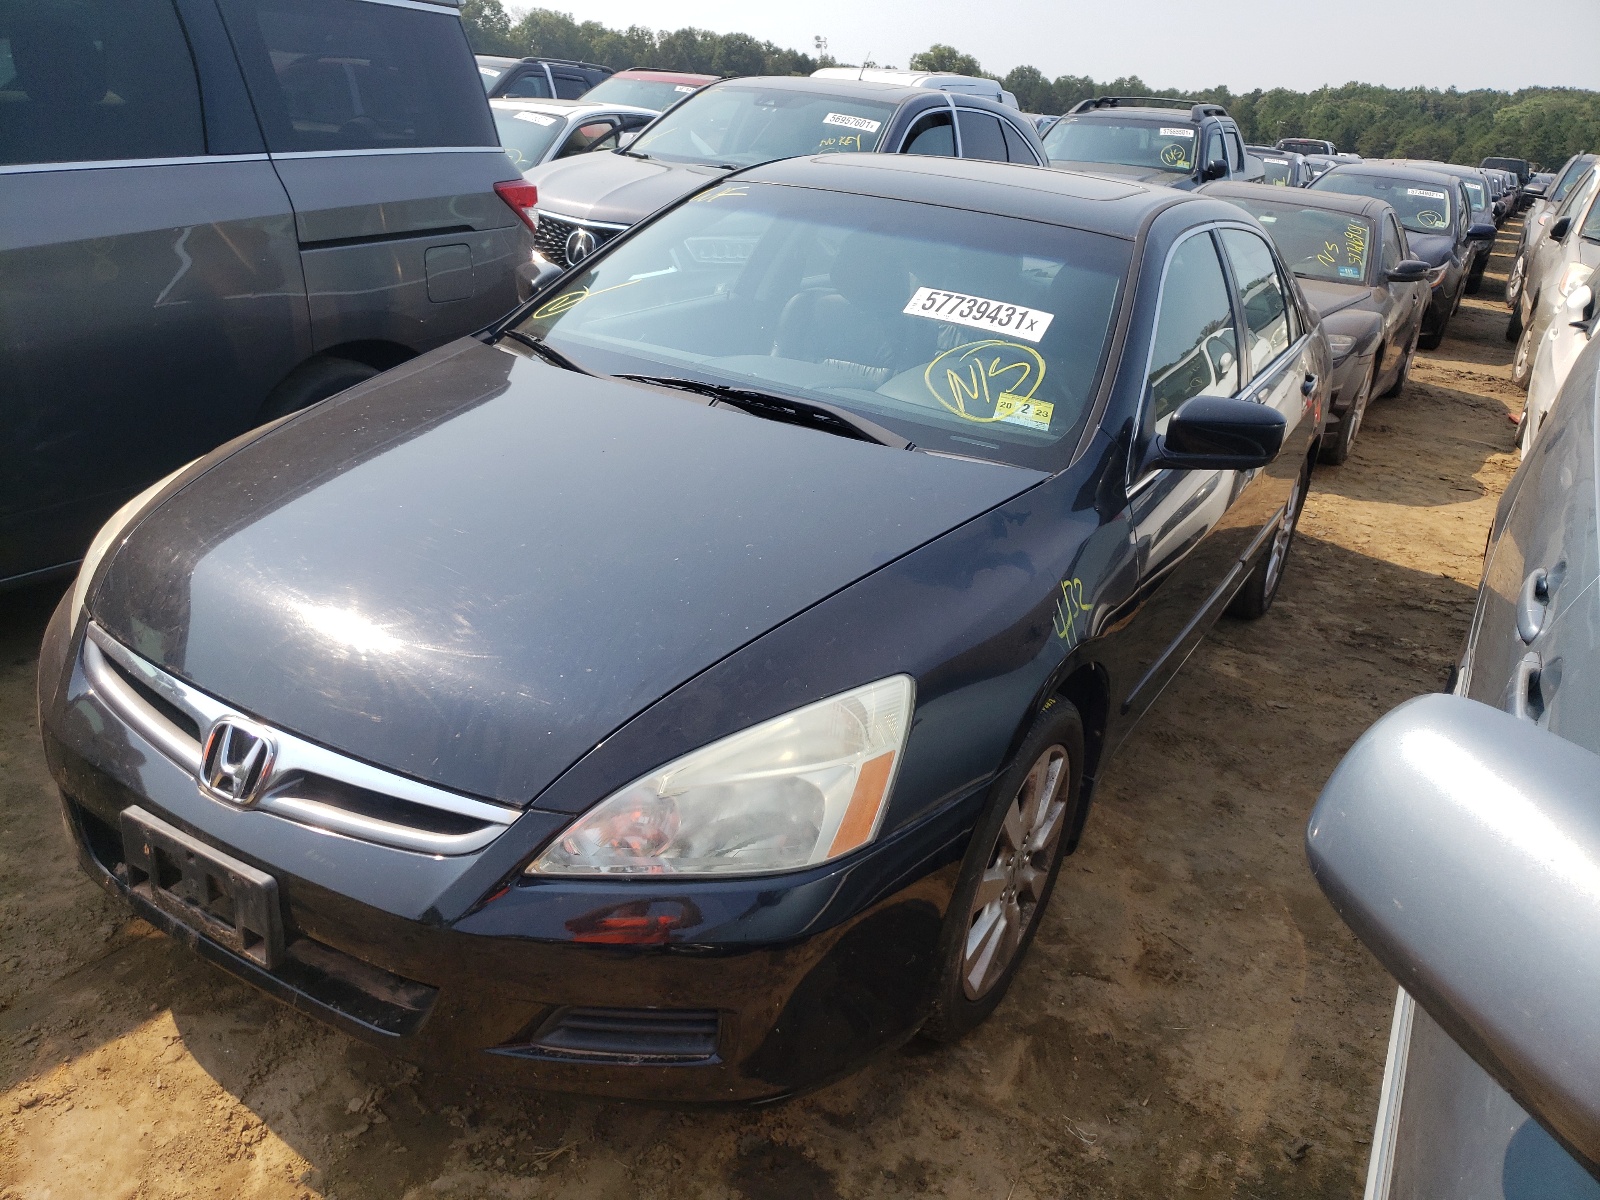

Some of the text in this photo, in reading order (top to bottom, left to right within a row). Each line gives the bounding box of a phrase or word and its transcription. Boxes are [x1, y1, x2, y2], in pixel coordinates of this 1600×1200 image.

[1000, 401, 1049, 418] 20 2 23
